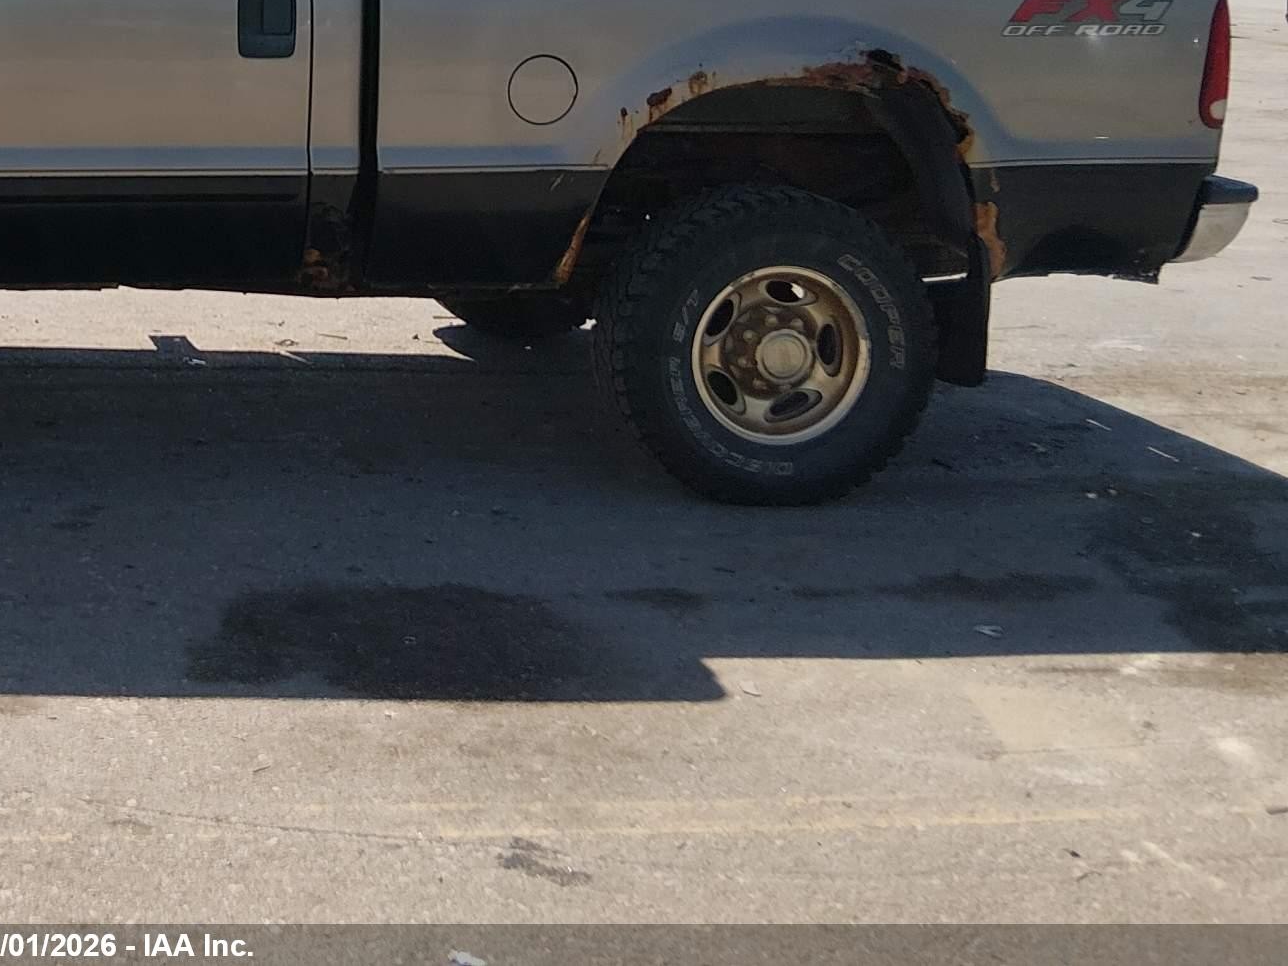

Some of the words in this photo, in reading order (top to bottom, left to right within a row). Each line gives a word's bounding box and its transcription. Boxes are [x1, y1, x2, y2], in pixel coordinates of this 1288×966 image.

[1002, 25, 1064, 36] OFF
[1074, 24, 1166, 36] ROAD
[837, 253, 907, 371] COOPER
